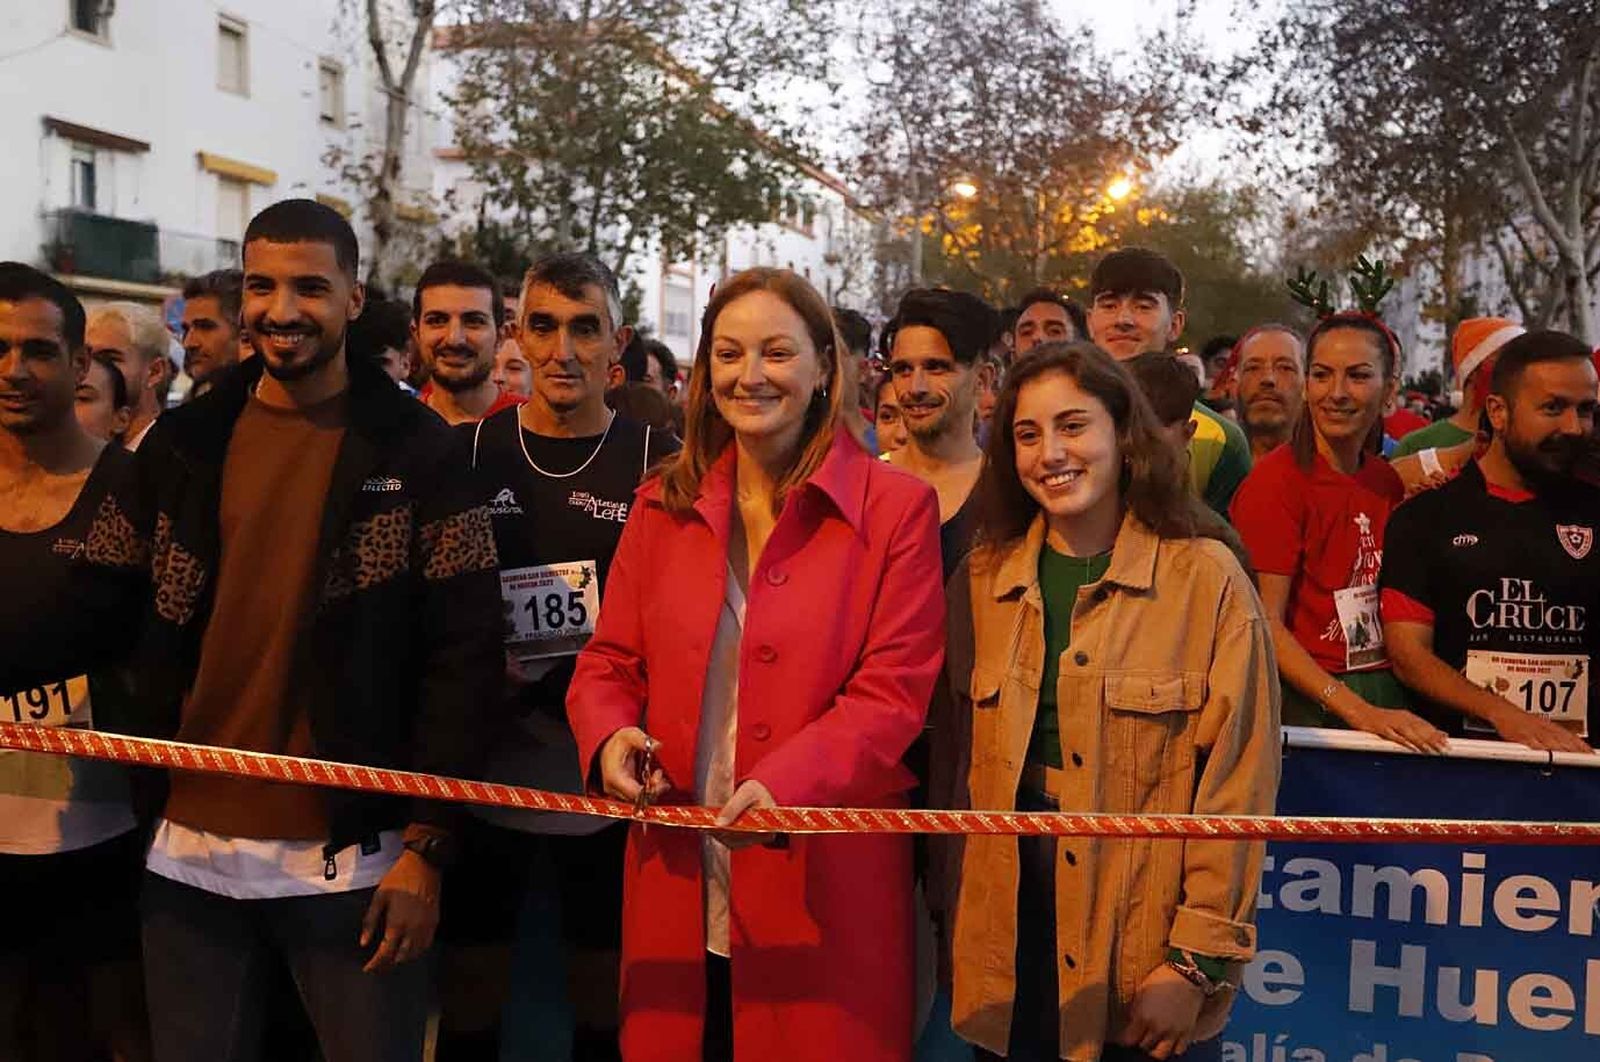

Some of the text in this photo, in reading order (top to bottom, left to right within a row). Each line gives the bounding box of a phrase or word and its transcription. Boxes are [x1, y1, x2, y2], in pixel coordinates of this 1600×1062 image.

[1500, 577, 1547, 602] EL
[524, 590, 587, 631] 185
[1466, 589, 1586, 631] CRUCE
[4, 682, 71, 722] 191
[1519, 680, 1577, 713] 107
